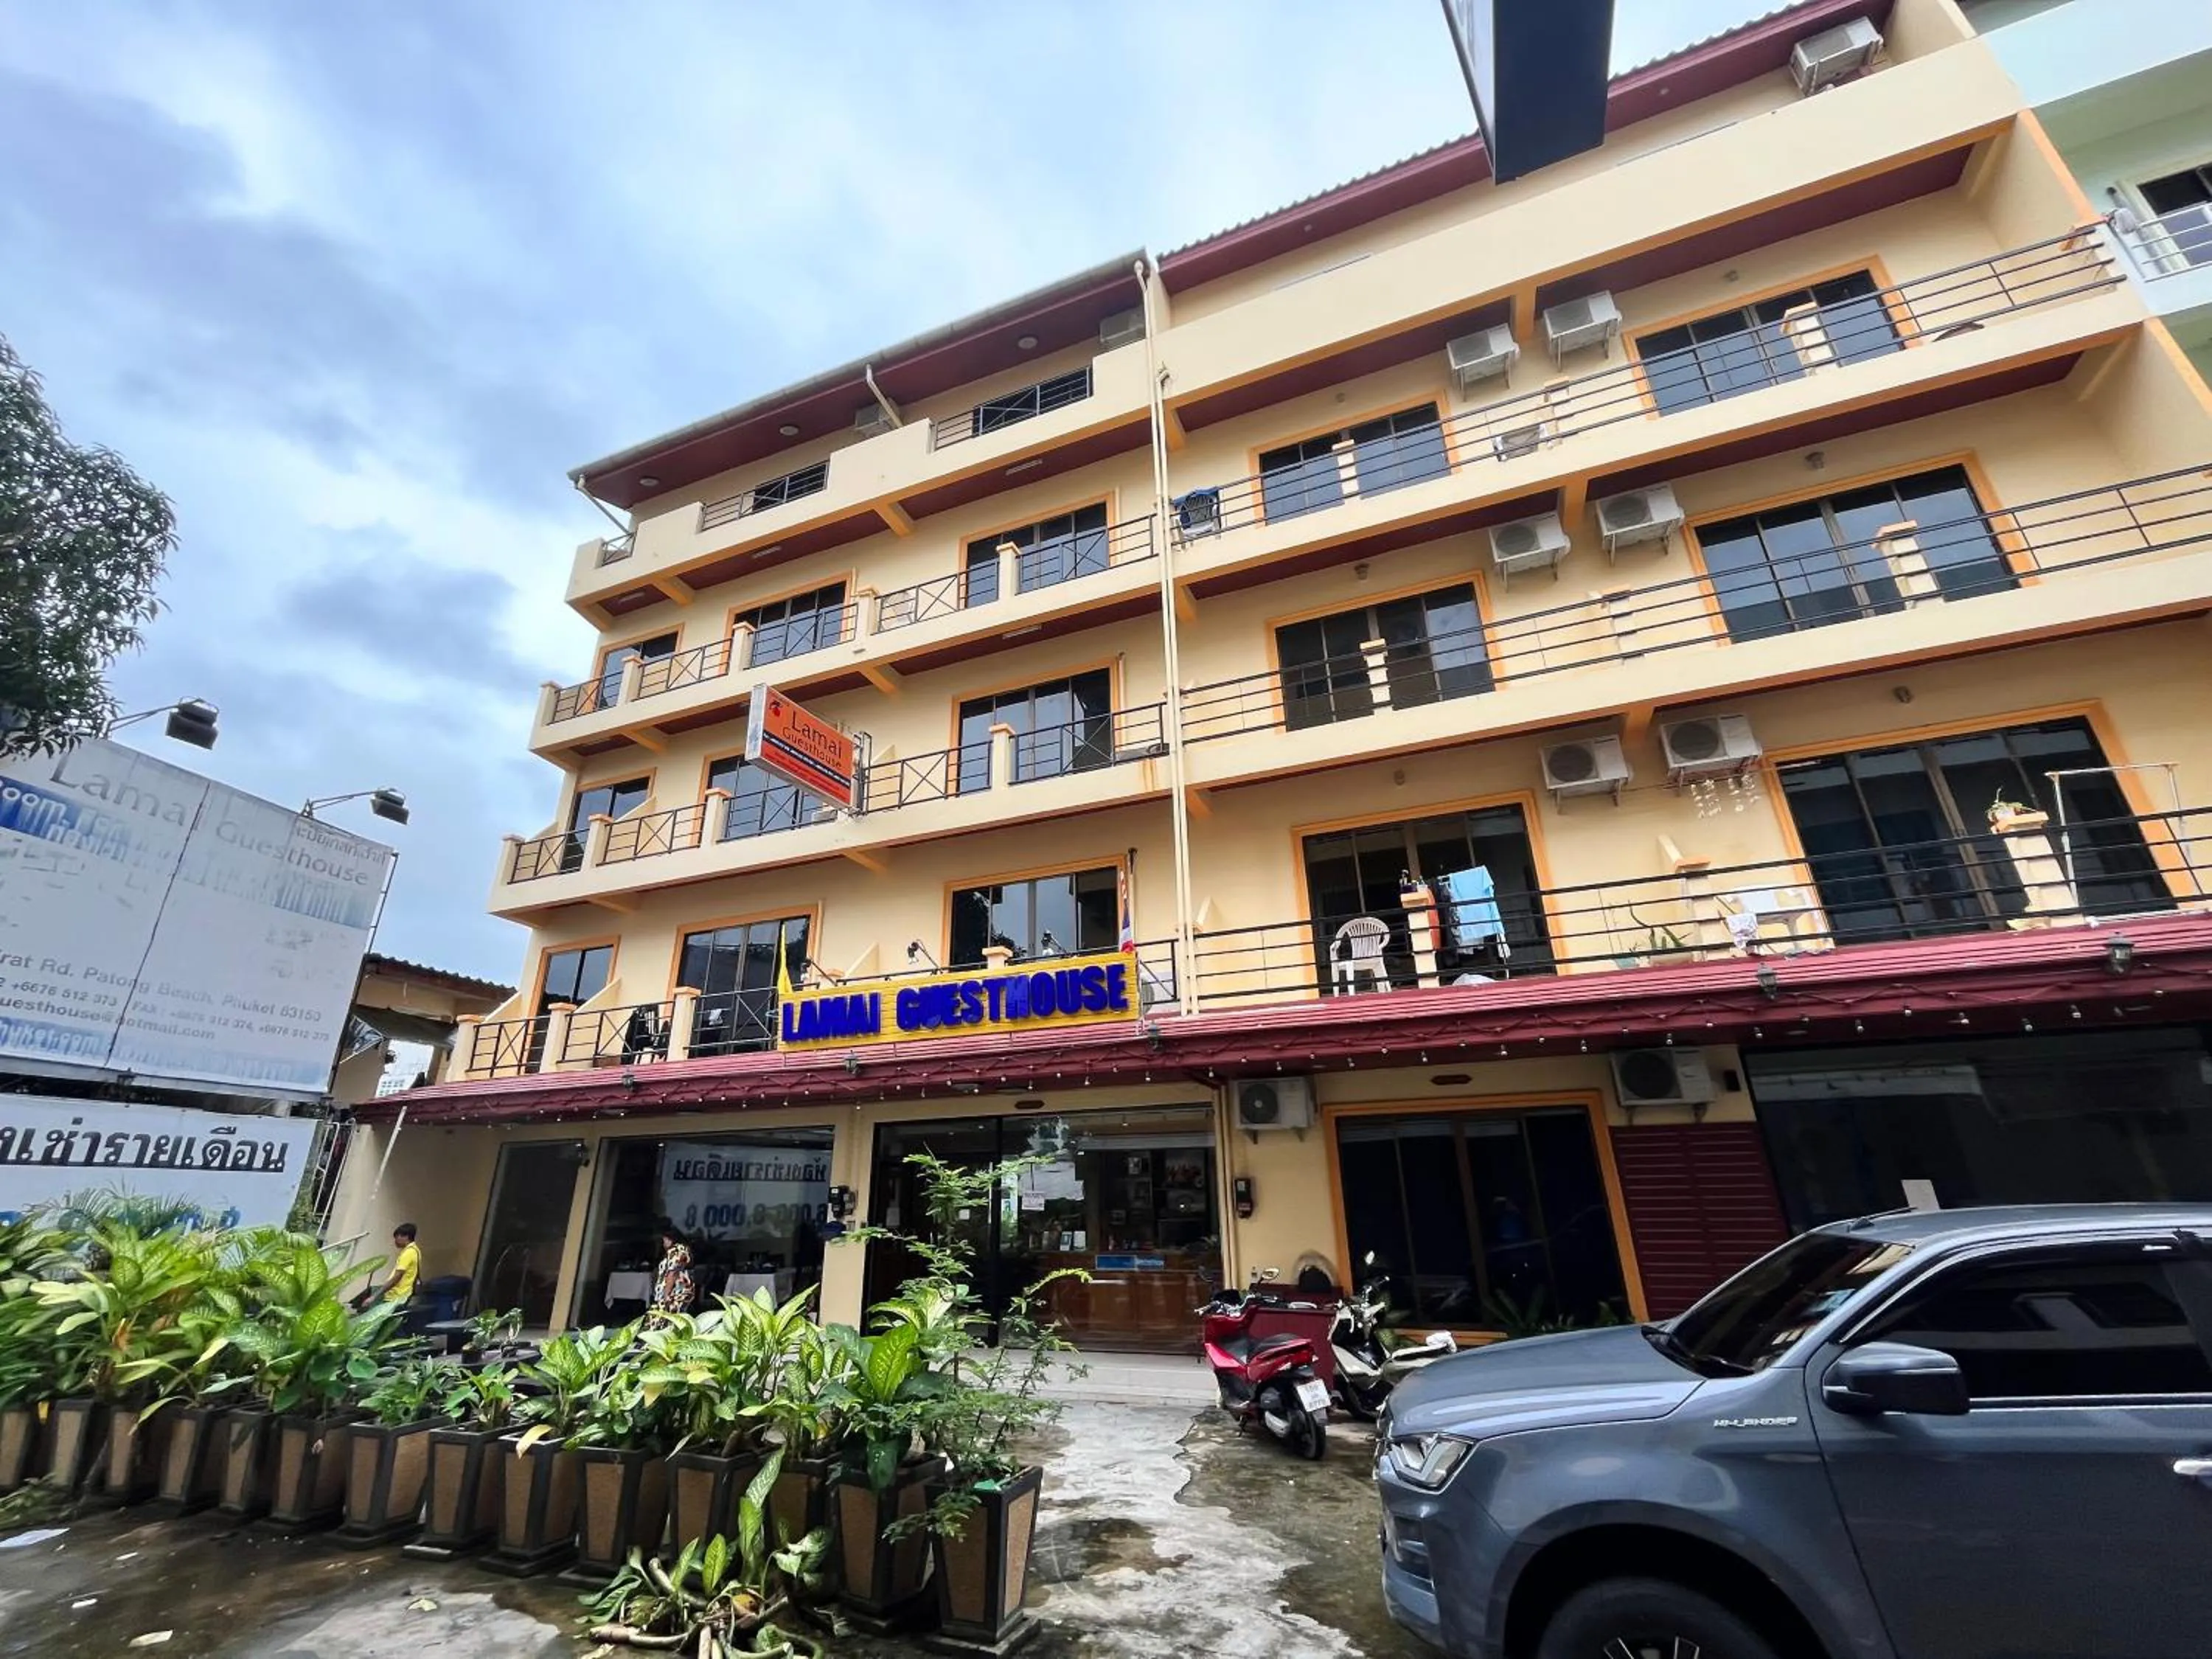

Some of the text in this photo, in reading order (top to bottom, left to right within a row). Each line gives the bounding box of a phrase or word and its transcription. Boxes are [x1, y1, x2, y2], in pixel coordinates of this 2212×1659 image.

[782, 727, 842, 768] Guesthouse
[791, 712, 842, 759] Lamai
[215, 819, 368, 886] Guesthouse
[222, 995, 276, 1015] Phuket
[280, 1006, 321, 1022] 83150
[782, 961, 1130, 1042] LAMAI GUESTHOUSE
